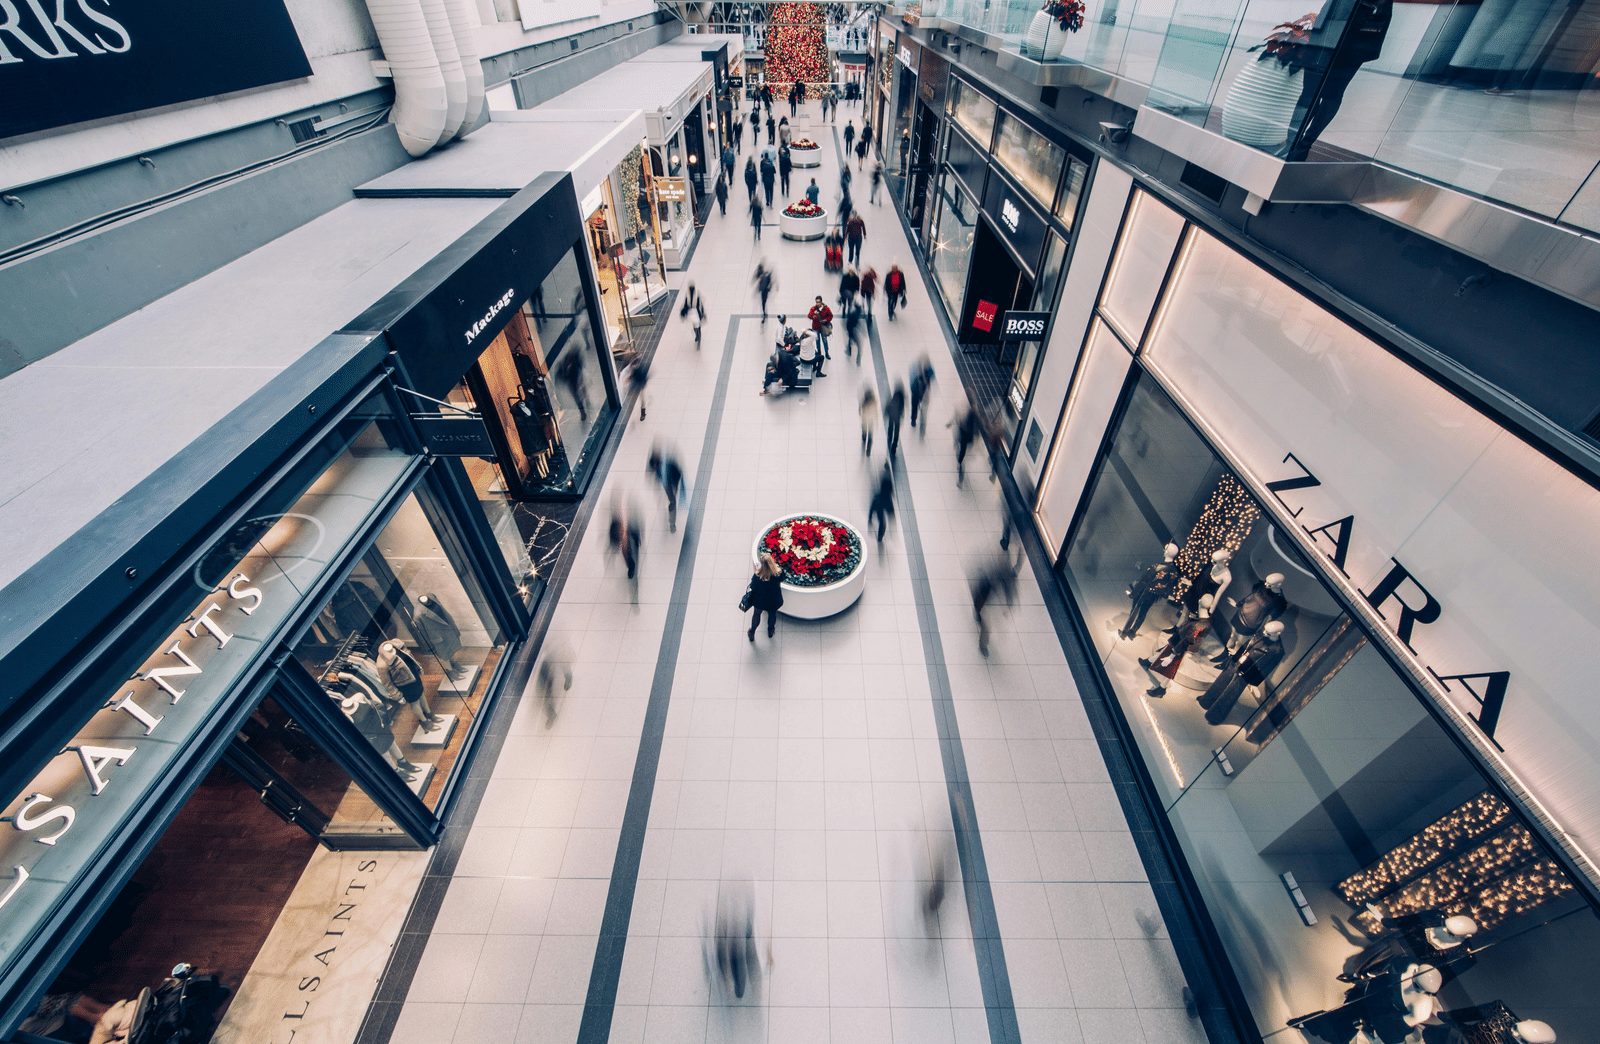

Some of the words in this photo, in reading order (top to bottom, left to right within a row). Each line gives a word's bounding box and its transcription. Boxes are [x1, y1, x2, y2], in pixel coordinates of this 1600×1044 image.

[464, 288, 515, 345] Mackage
[976, 310, 994, 323] SALE
[1007, 319, 1044, 331] BOSS
[527, 515, 546, 553] ackage
[1265, 452, 1511, 753] ZARA
